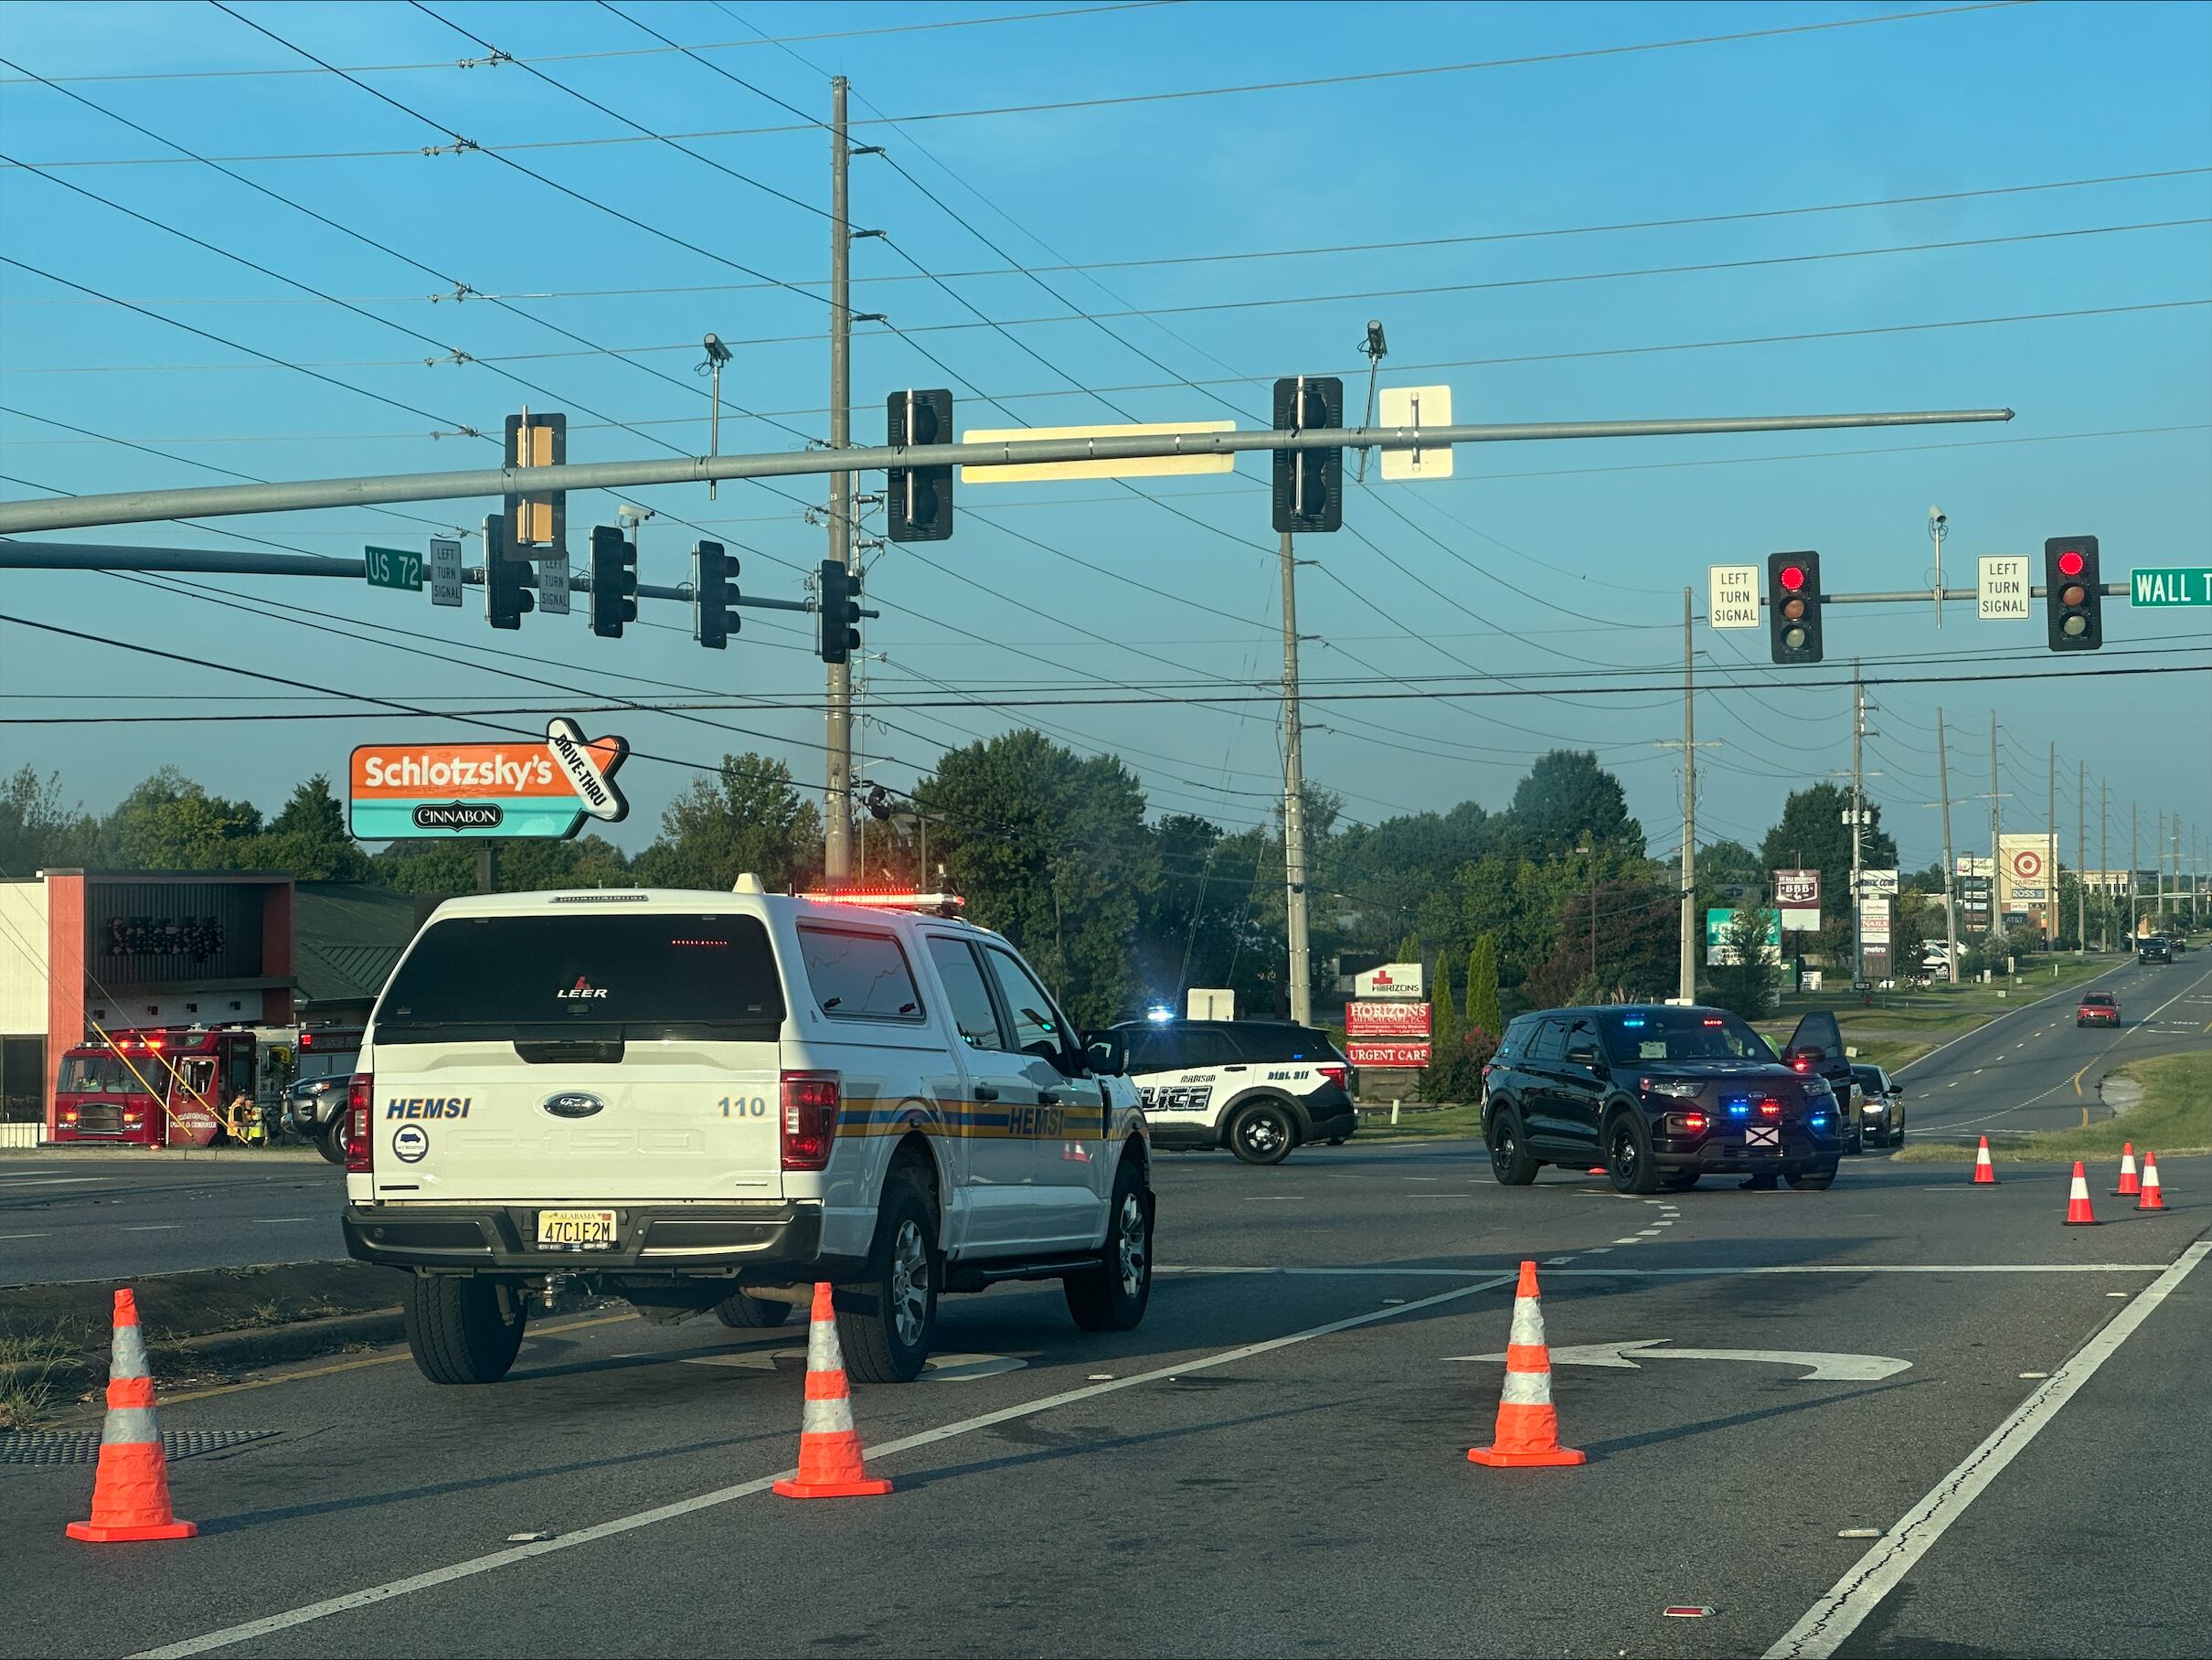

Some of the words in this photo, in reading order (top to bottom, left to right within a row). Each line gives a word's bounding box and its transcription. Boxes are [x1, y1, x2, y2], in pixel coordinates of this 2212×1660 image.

[437, 548, 455, 561] LEFT
[368, 551, 389, 582] US
[399, 555, 419, 586] 72
[545, 559, 562, 570] LEFT
[1990, 563, 2018, 575] LEFT
[437, 566, 456, 580] TURN
[1721, 572, 1749, 585] LEFT
[545, 573, 564, 588] TURN
[434, 584, 460, 600] SIGNAL
[1988, 581, 2019, 594] TURN
[2136, 574, 2192, 602] WALL
[541, 591, 568, 607] SIGNAL
[1719, 591, 1749, 603] TURN
[1982, 600, 2026, 612] SIGNAL
[1715, 609, 1757, 622] SIGNAL
[365, 754, 553, 792] Schlotzsky's
[553, 733, 608, 807] DRIVE-THRU
[417, 808, 497, 824] CINNABON
[1785, 884, 1810, 893] BBB
[1862, 920, 1888, 928] NAILS
[557, 989, 608, 998] LEER
[1350, 1006, 1427, 1016] HORIZONS
[1349, 1049, 1396, 1060] URGENT
[1398, 1049, 1428, 1060] CARE
[1180, 1074, 1217, 1083] MADISON
[1266, 1070, 1291, 1080] DIAL
[1292, 1070, 1310, 1080] 911
[1138, 1085, 1213, 1112] LICE
[386, 1097, 473, 1120] HEMSI
[718, 1096, 766, 1117] 110
[1009, 1106, 1064, 1136] HEMSI
[444, 1128, 706, 1155] F-150
[545, 1222, 611, 1242] 47C1E2M
